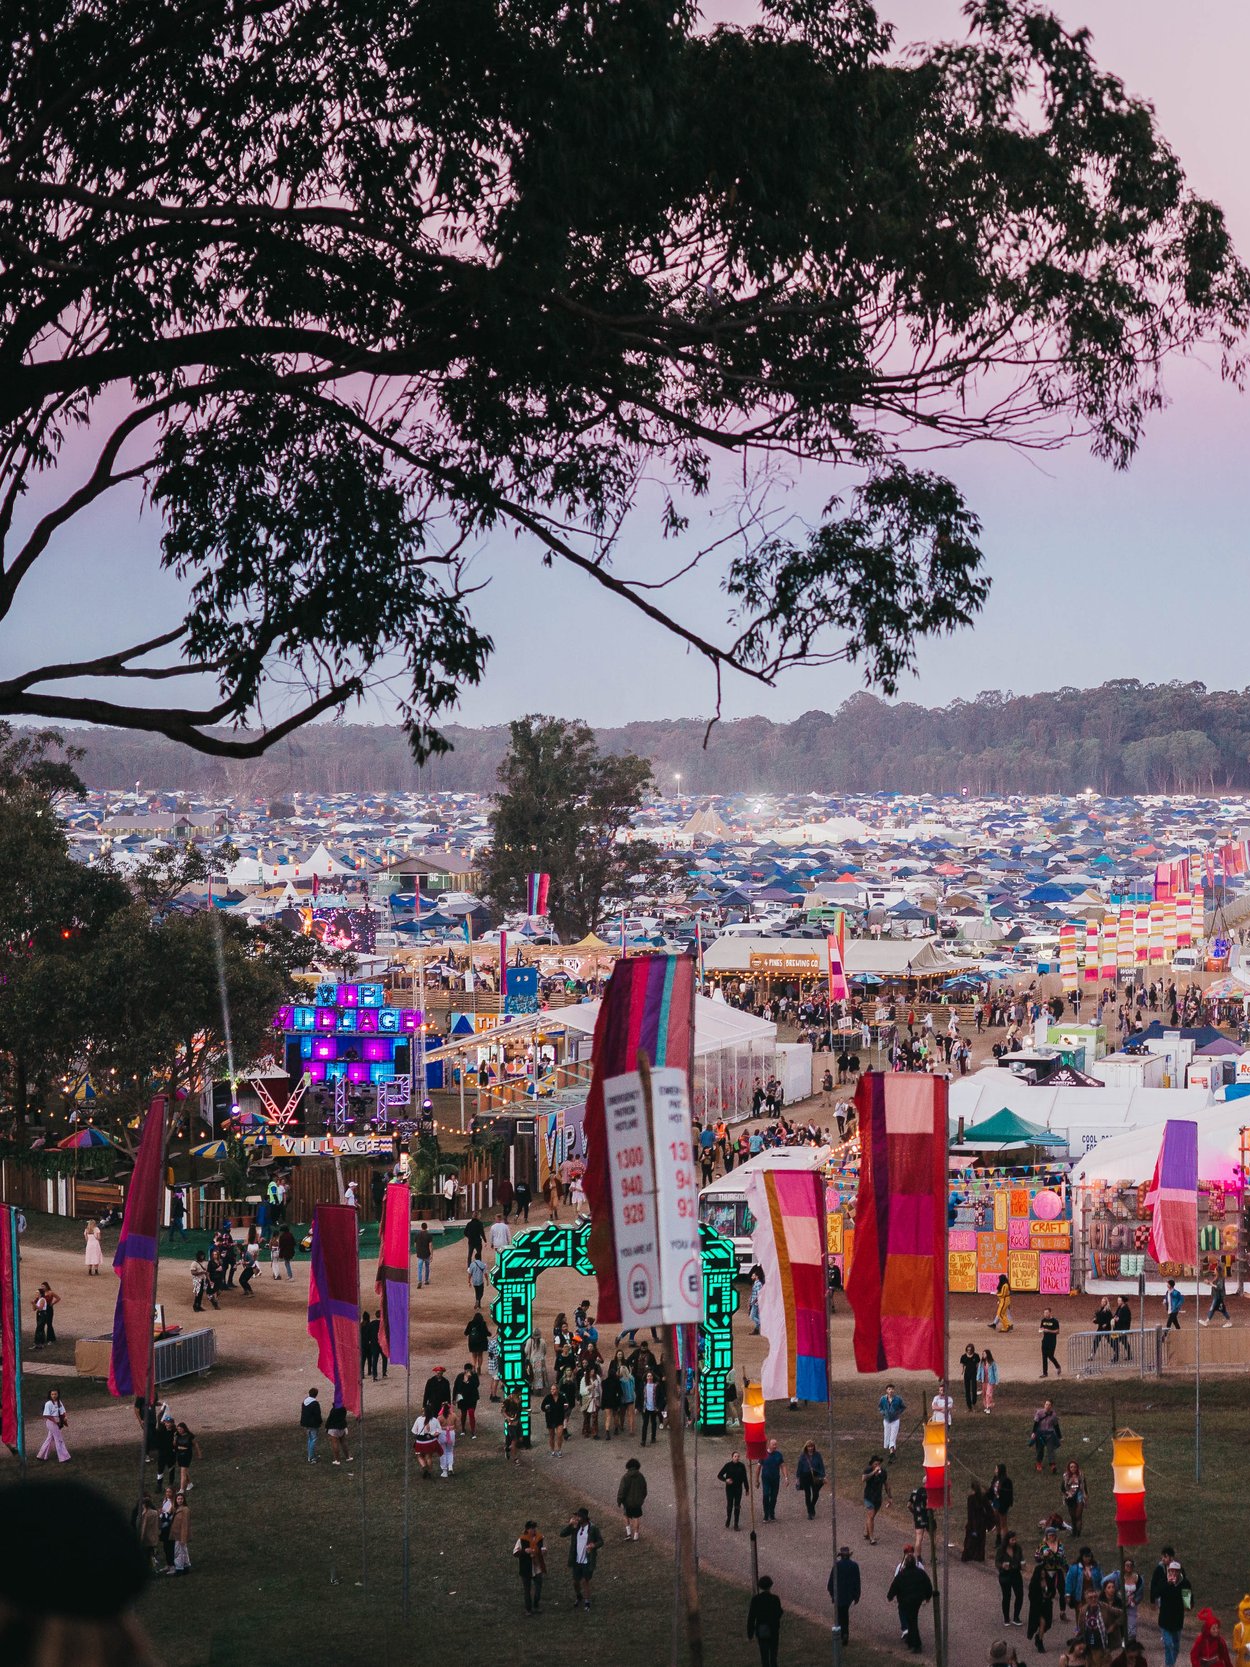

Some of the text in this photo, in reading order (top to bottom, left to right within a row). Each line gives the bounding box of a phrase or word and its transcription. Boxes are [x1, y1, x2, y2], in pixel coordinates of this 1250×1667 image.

[769, 959, 783, 967] PINES
[785, 959, 810, 968] BREWING
[316, 985, 376, 1005] VIP
[275, 1008, 415, 1030] VILLAGE
[1081, 1135, 1098, 1143] COOL
[283, 1138, 382, 1153] VILLAGE
[616, 1145, 644, 1170] 1300
[1032, 1222, 1066, 1233] CRAFT
[1010, 1236, 1028, 1247] ROCK
[957, 1254, 971, 1263] THIS
[1015, 1278, 1031, 1288] EYE
